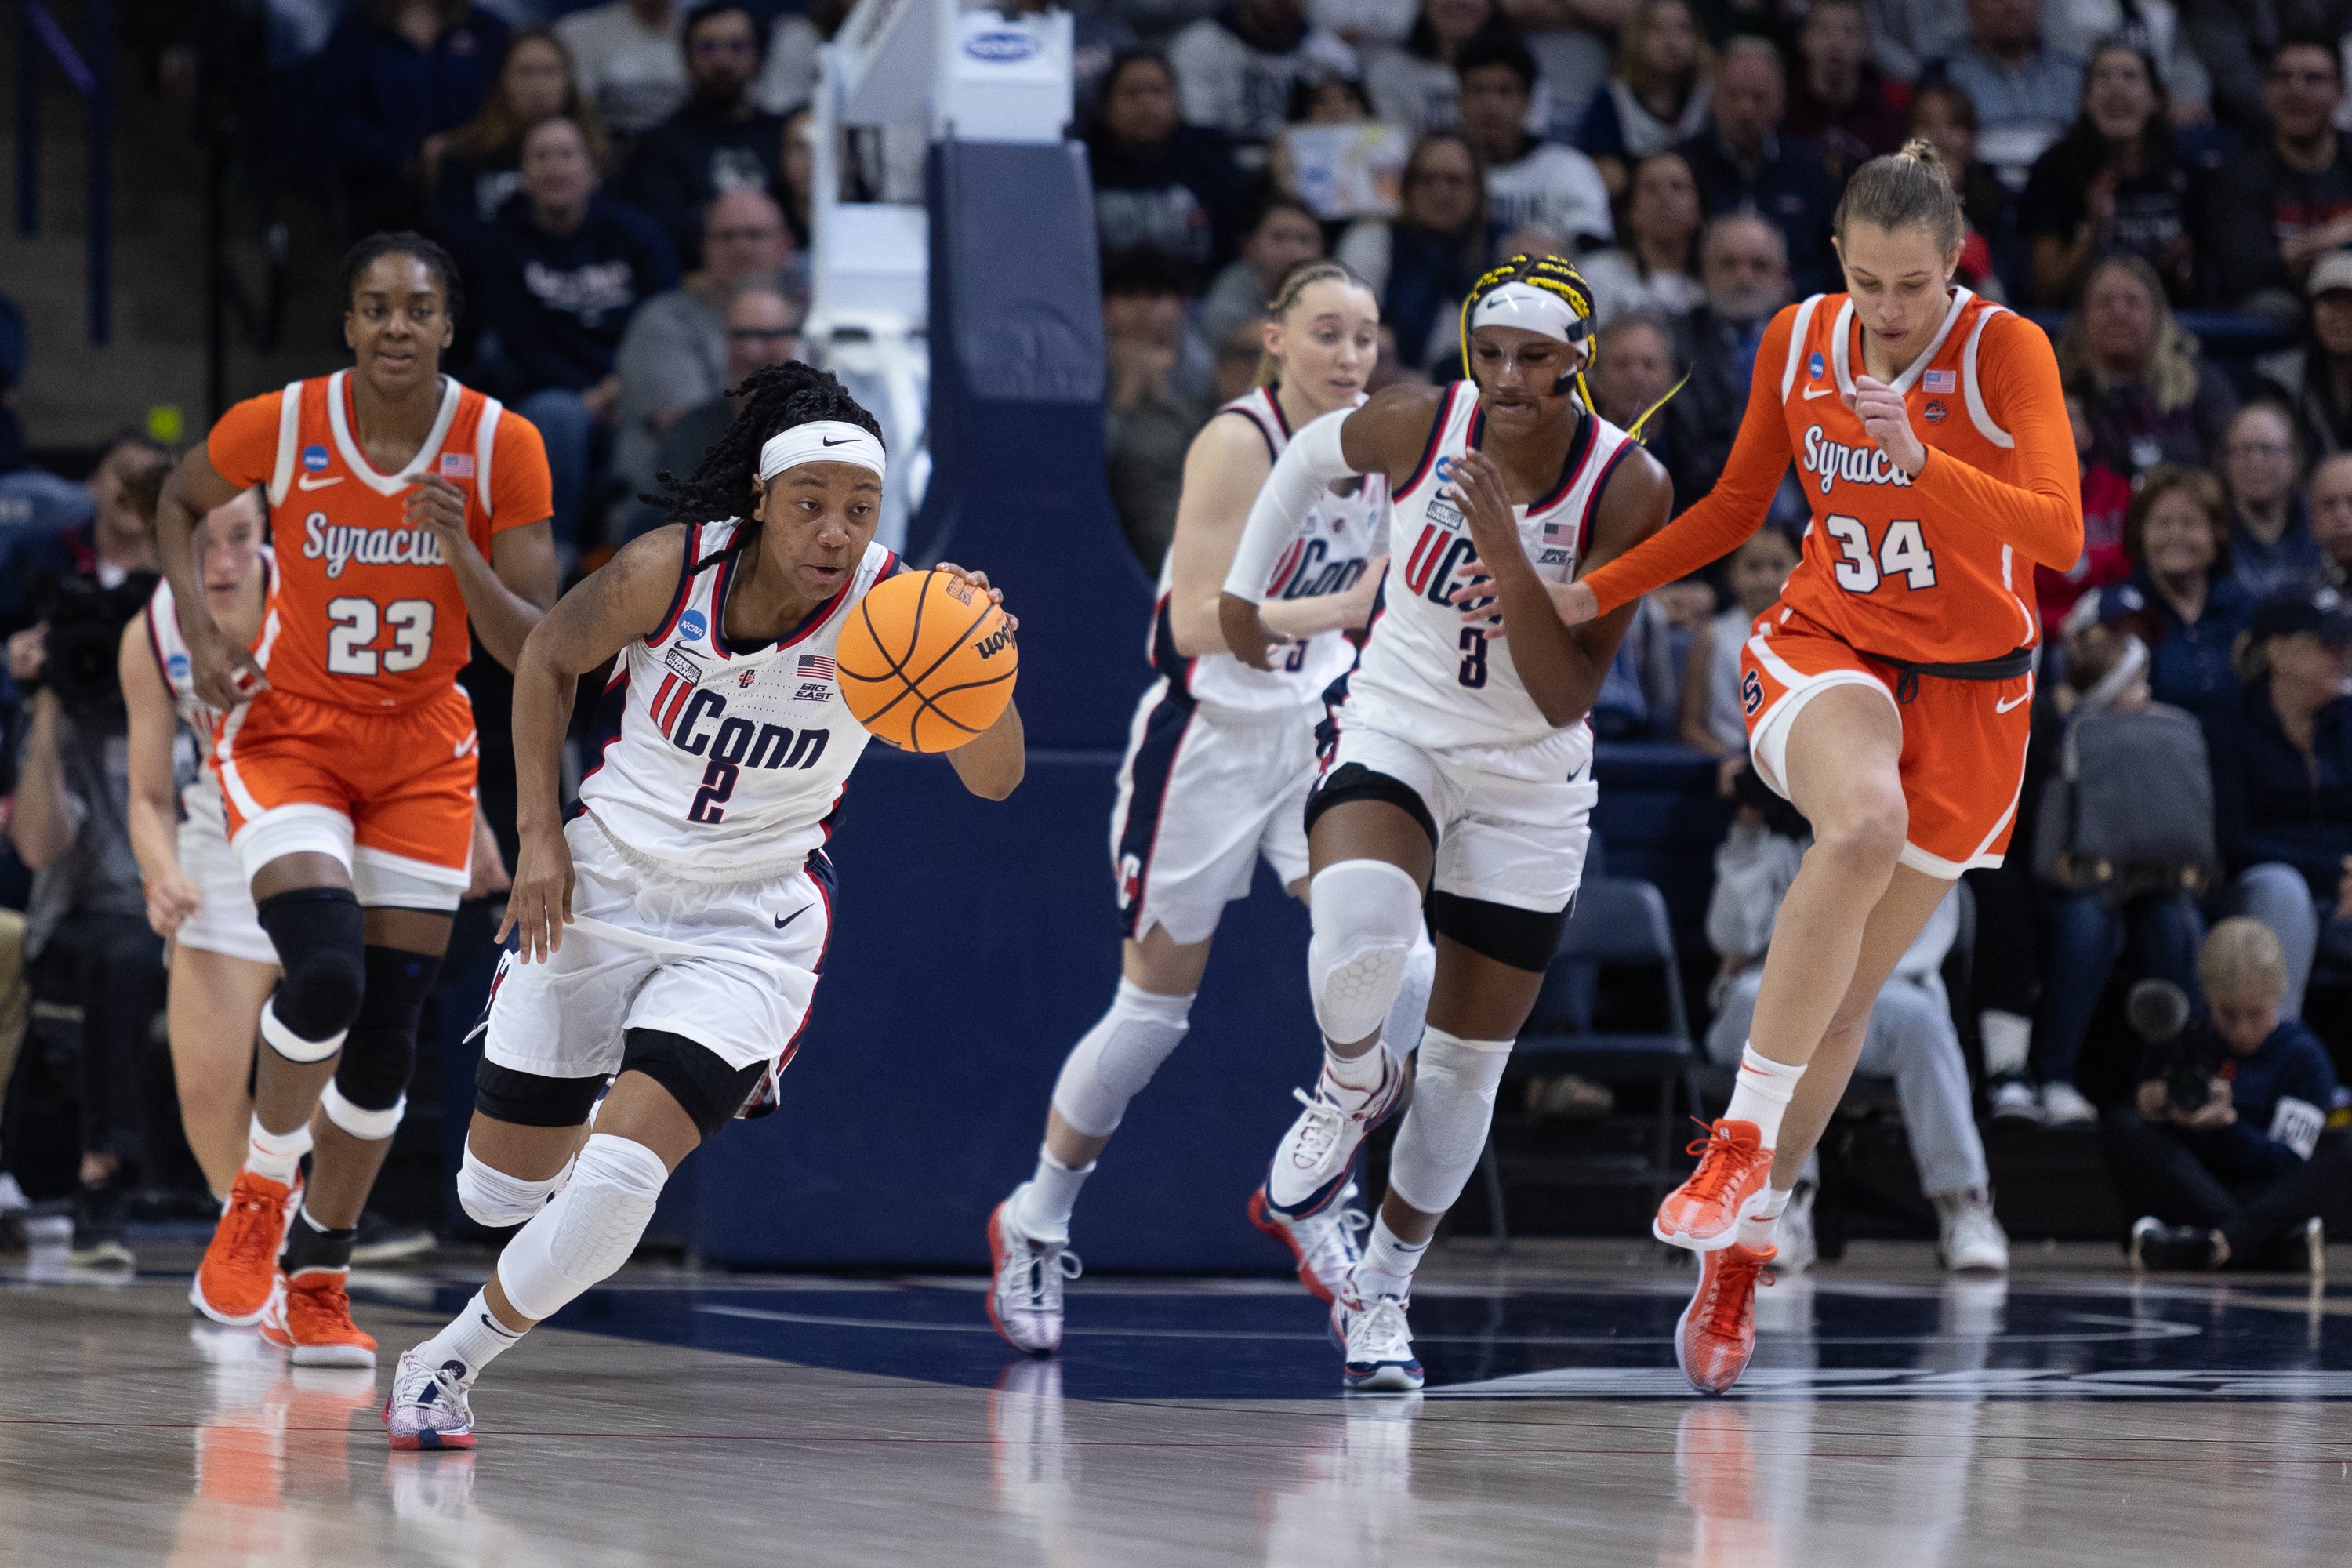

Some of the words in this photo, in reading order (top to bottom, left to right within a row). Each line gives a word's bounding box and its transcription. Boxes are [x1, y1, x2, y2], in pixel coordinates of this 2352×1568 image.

[1804, 424, 1913, 495] Syracu
[303, 511, 448, 579] Syracu
[1266, 537, 1368, 601] UCon
[1825, 513, 1938, 594] 34
[327, 596, 435, 677] 23
[681, 620, 704, 637] NCAA
[1459, 627, 1489, 689] 3
[666, 658, 698, 684] CHANGE
[675, 655, 691, 671] BE
[800, 683, 828, 692] BIG
[1743, 670, 1764, 716] S
[650, 671, 830, 771] UConn
[795, 691, 833, 700] EAST
[687, 760, 739, 824] 2
